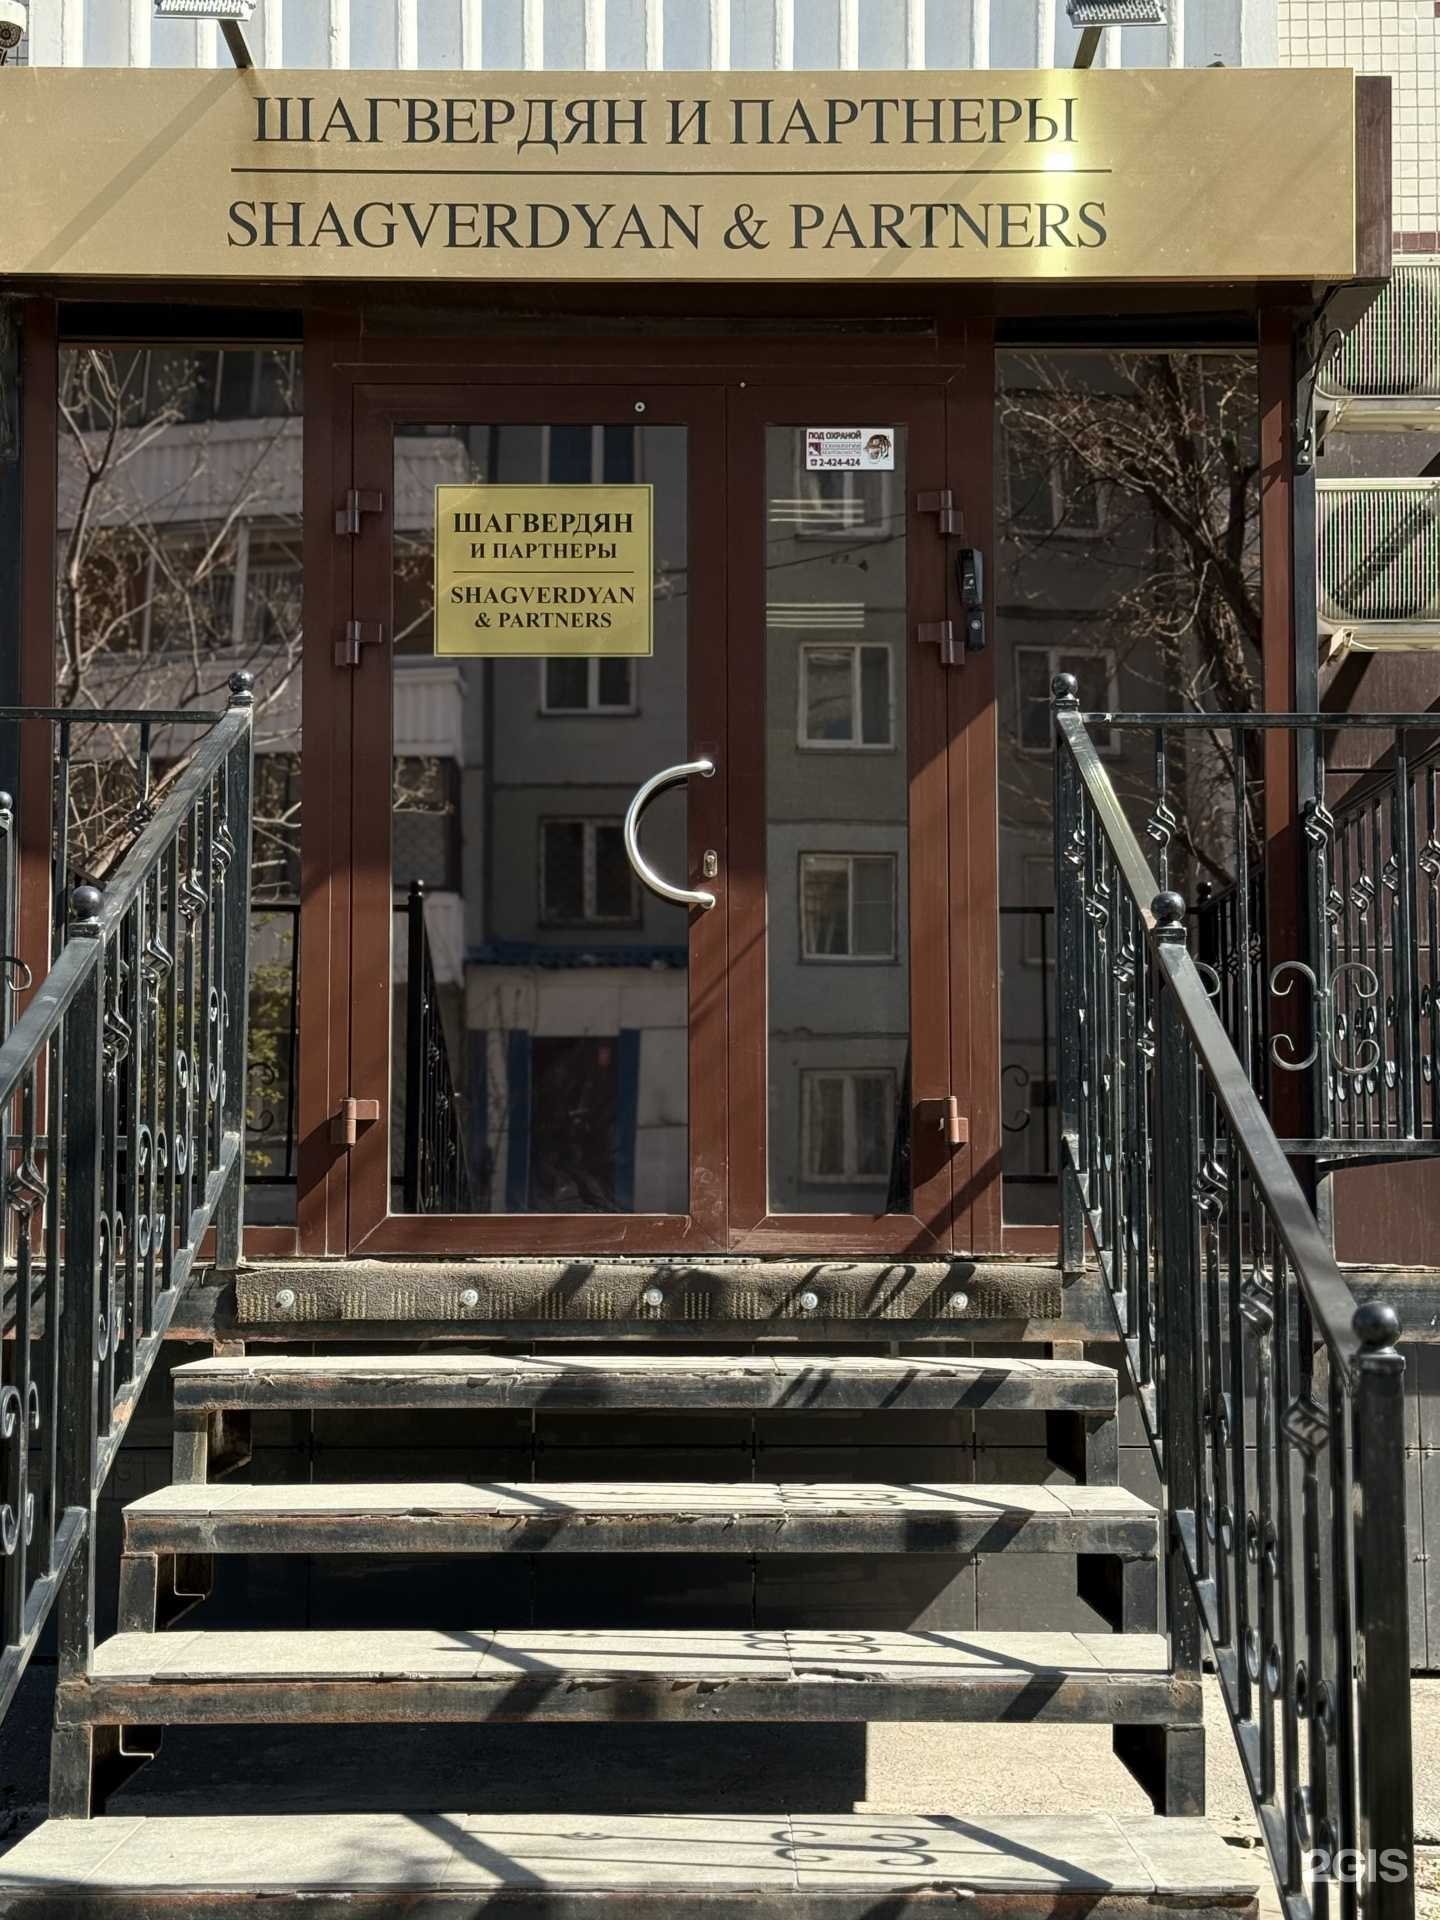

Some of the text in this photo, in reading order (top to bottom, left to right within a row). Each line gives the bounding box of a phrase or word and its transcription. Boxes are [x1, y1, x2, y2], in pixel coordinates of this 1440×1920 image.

[252, 97, 1079, 155] ШАГВЕРДЯН И ПАРТНЕРЫ
[227, 200, 1107, 249] SHAGVERDYAN & PARTNERS
[808, 430, 862, 440] ПОД ОХРАНОЙ
[819, 458, 860, 467] 2-424-424
[453, 512, 633, 537] ШАГВЕРДЯН
[470, 543, 617, 559] И ПАРТНЕРЫ
[450, 586, 635, 604] SHAGVERDYAN
[474, 612, 612, 628] & PARTNERS
